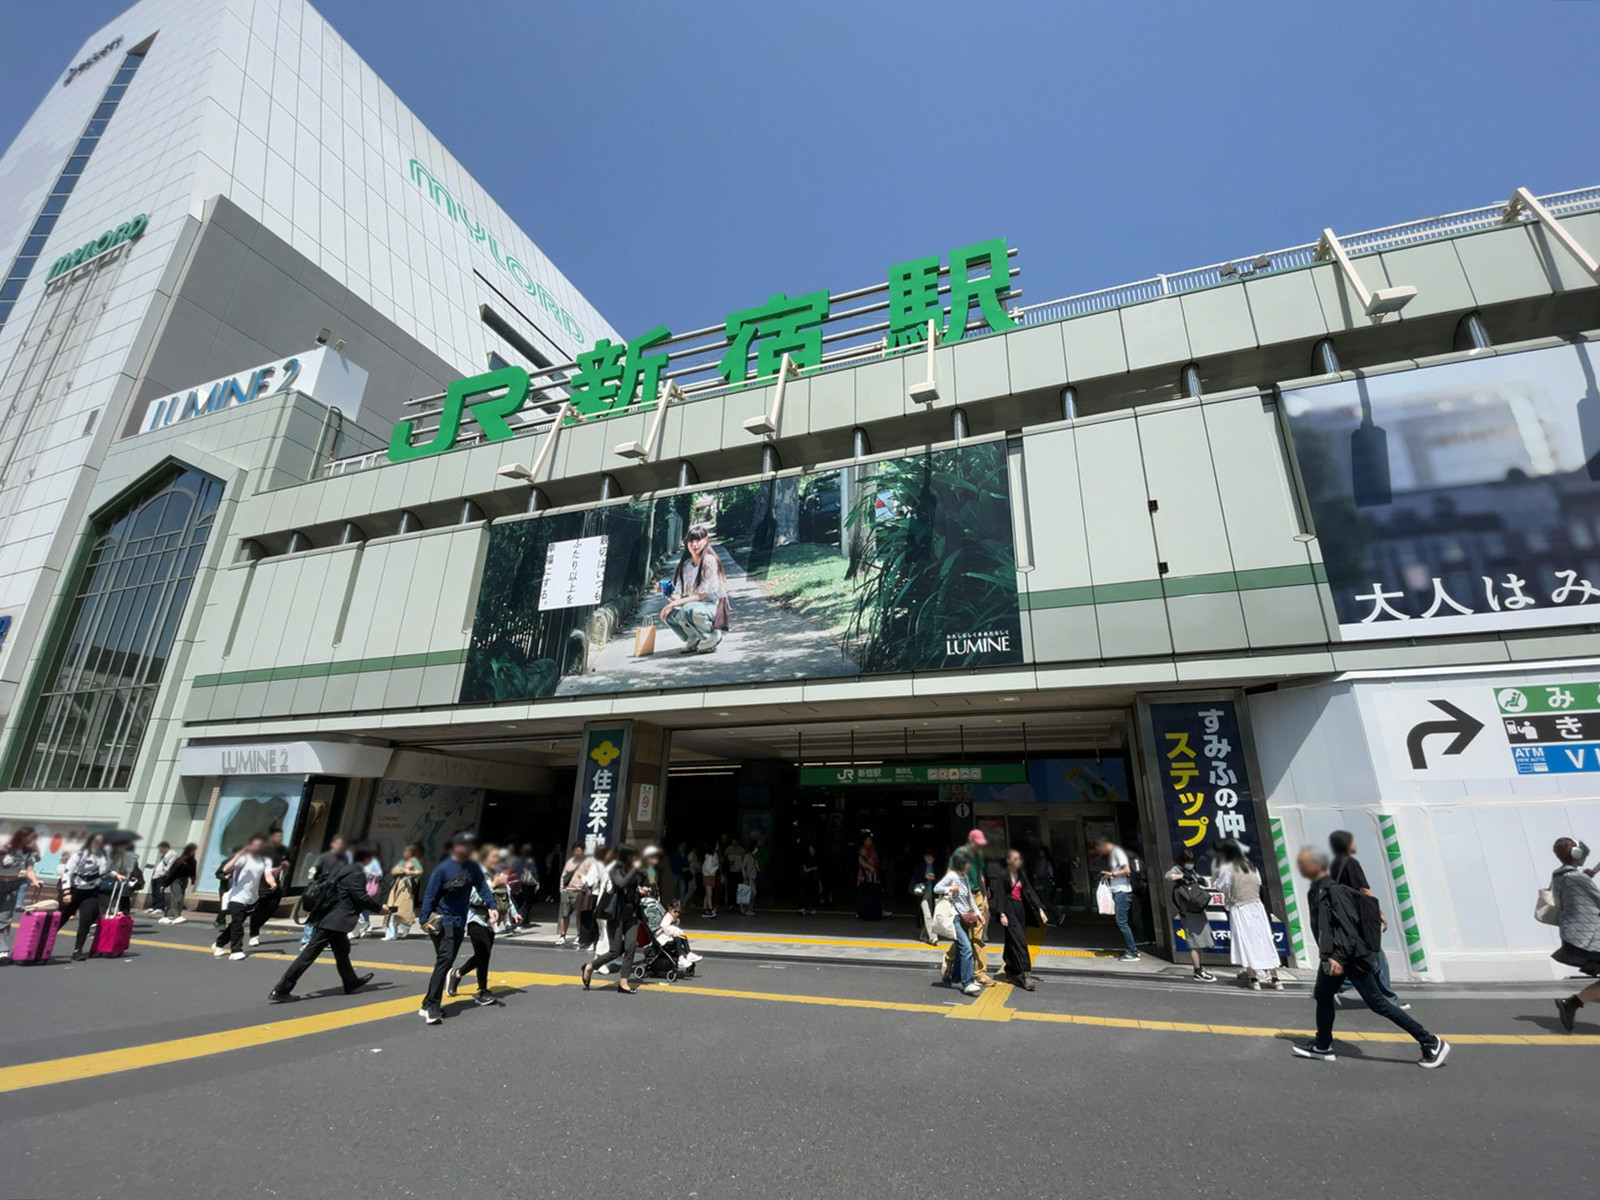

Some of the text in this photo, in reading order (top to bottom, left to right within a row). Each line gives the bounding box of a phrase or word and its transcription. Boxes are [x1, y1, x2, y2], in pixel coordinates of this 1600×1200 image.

[151, 366, 275, 431] LUMINE
[566, 540, 582, 604] ふたり以上を
[1355, 569, 1600, 624] 大人はみ
[946, 636, 1010, 655] LUMINE
[1555, 716, 1583, 739] き
[222, 749, 289, 773] LUMINE 2
[1515, 748, 1545, 758] ATM
[837, 769, 854, 780] JR
[1165, 732, 1209, 847] ステップ
[1198, 708, 1250, 853] すみふの仲
